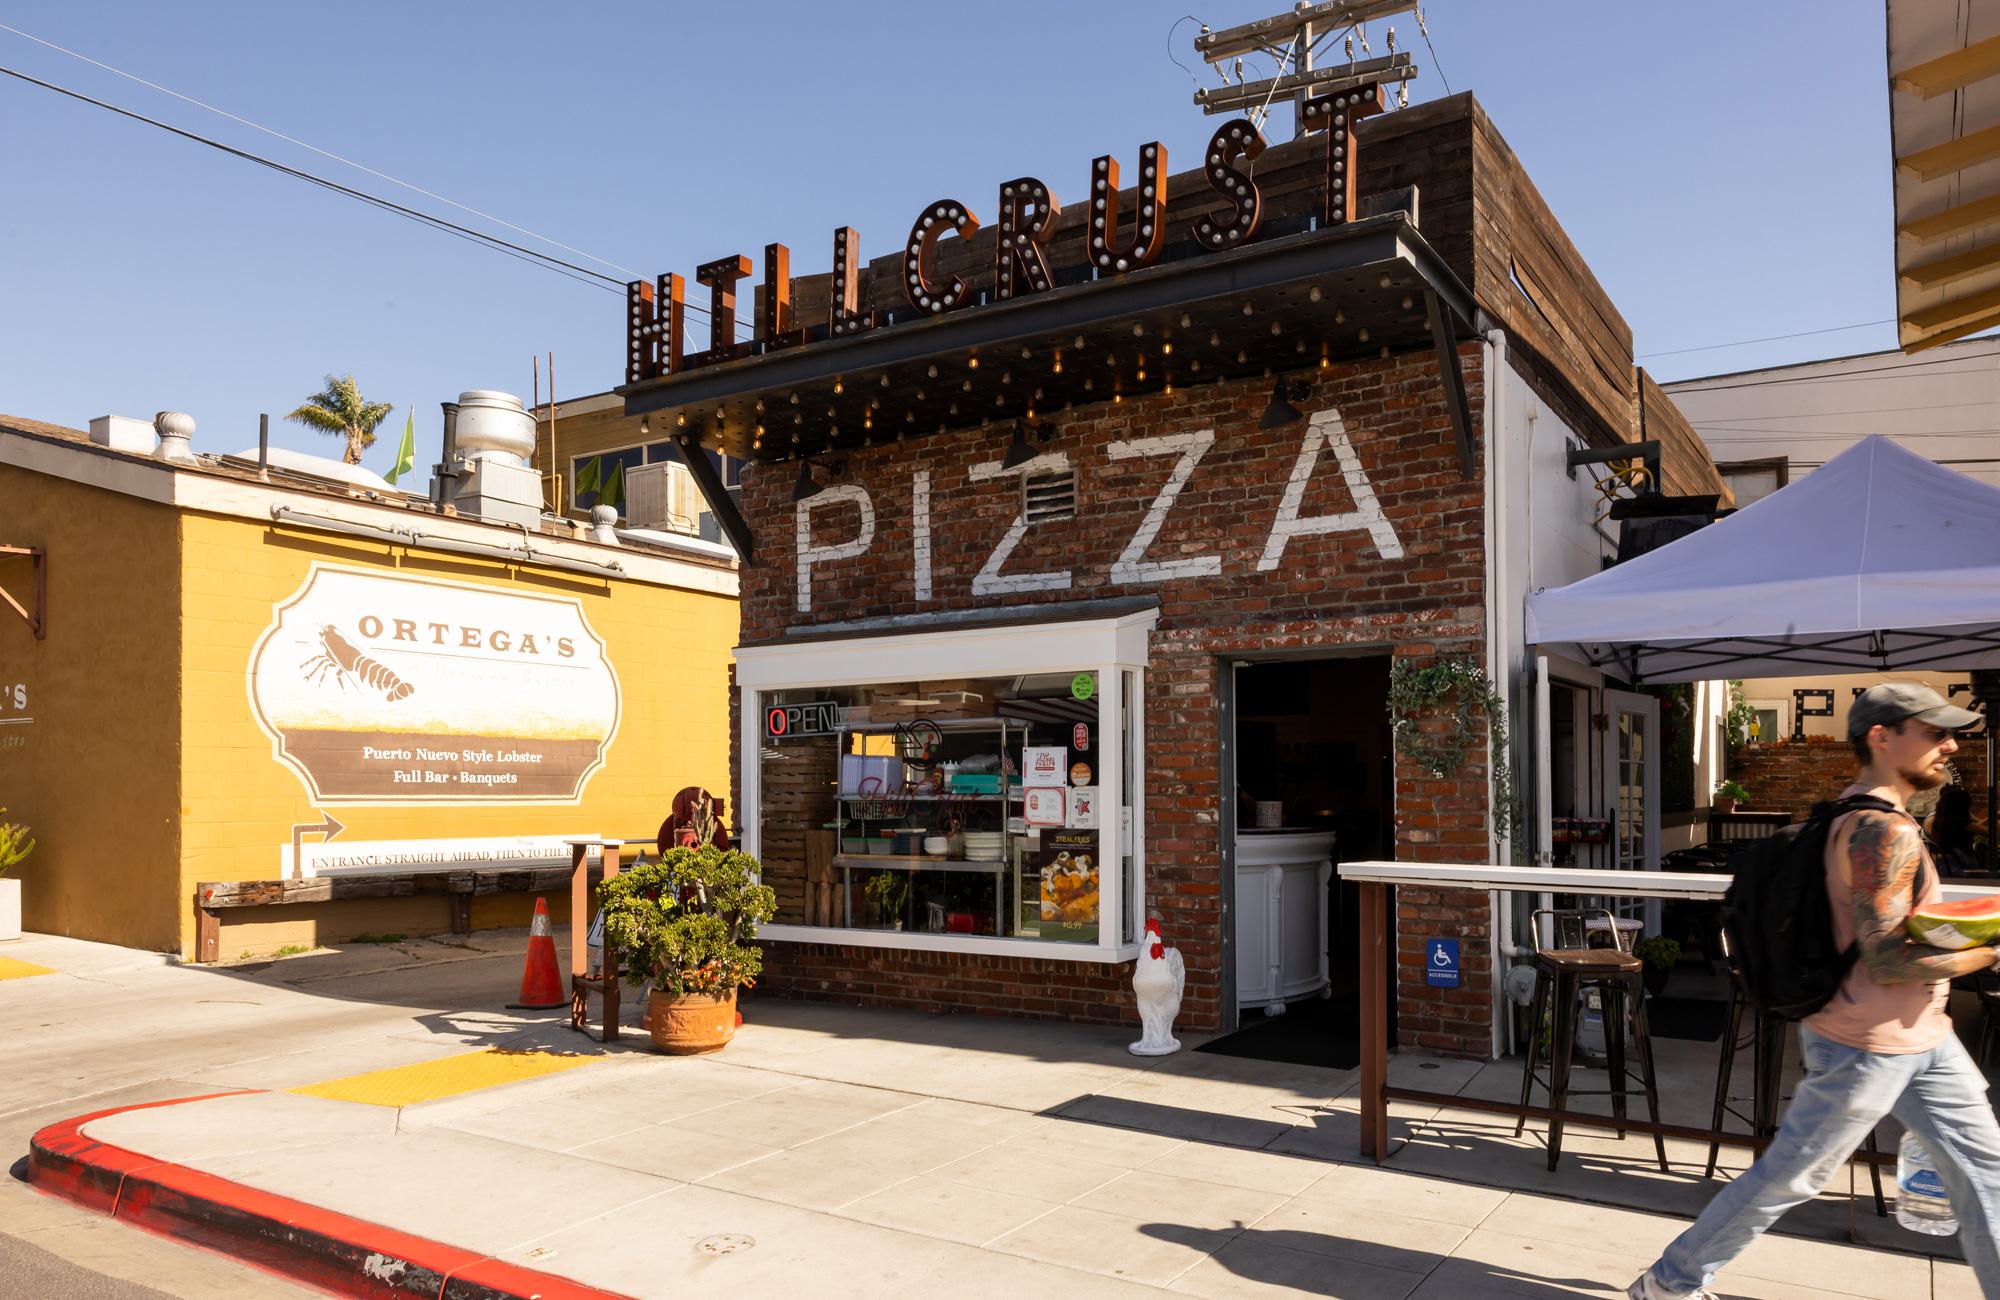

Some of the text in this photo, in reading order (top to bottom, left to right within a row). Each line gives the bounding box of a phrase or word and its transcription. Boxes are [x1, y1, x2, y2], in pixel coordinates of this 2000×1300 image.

[796, 408, 1404, 612] PIZZA
[358, 615, 575, 658] ORTEGA'S
[0, 683, 27, 710] 'S
[769, 705, 834, 735] OPEN
[363, 746, 543, 764] Puerto Nuevo Style Lobster
[394, 770, 518, 786] Full Bar Banquets
[312, 855, 381, 868] ENTRANCE
[385, 852, 446, 865] STRAIGHT
[450, 850, 493, 862] AHEAD,
[496, 849, 525, 859] THEN
[525, 848, 541, 858] TO
[544, 847, 564, 857] THE
